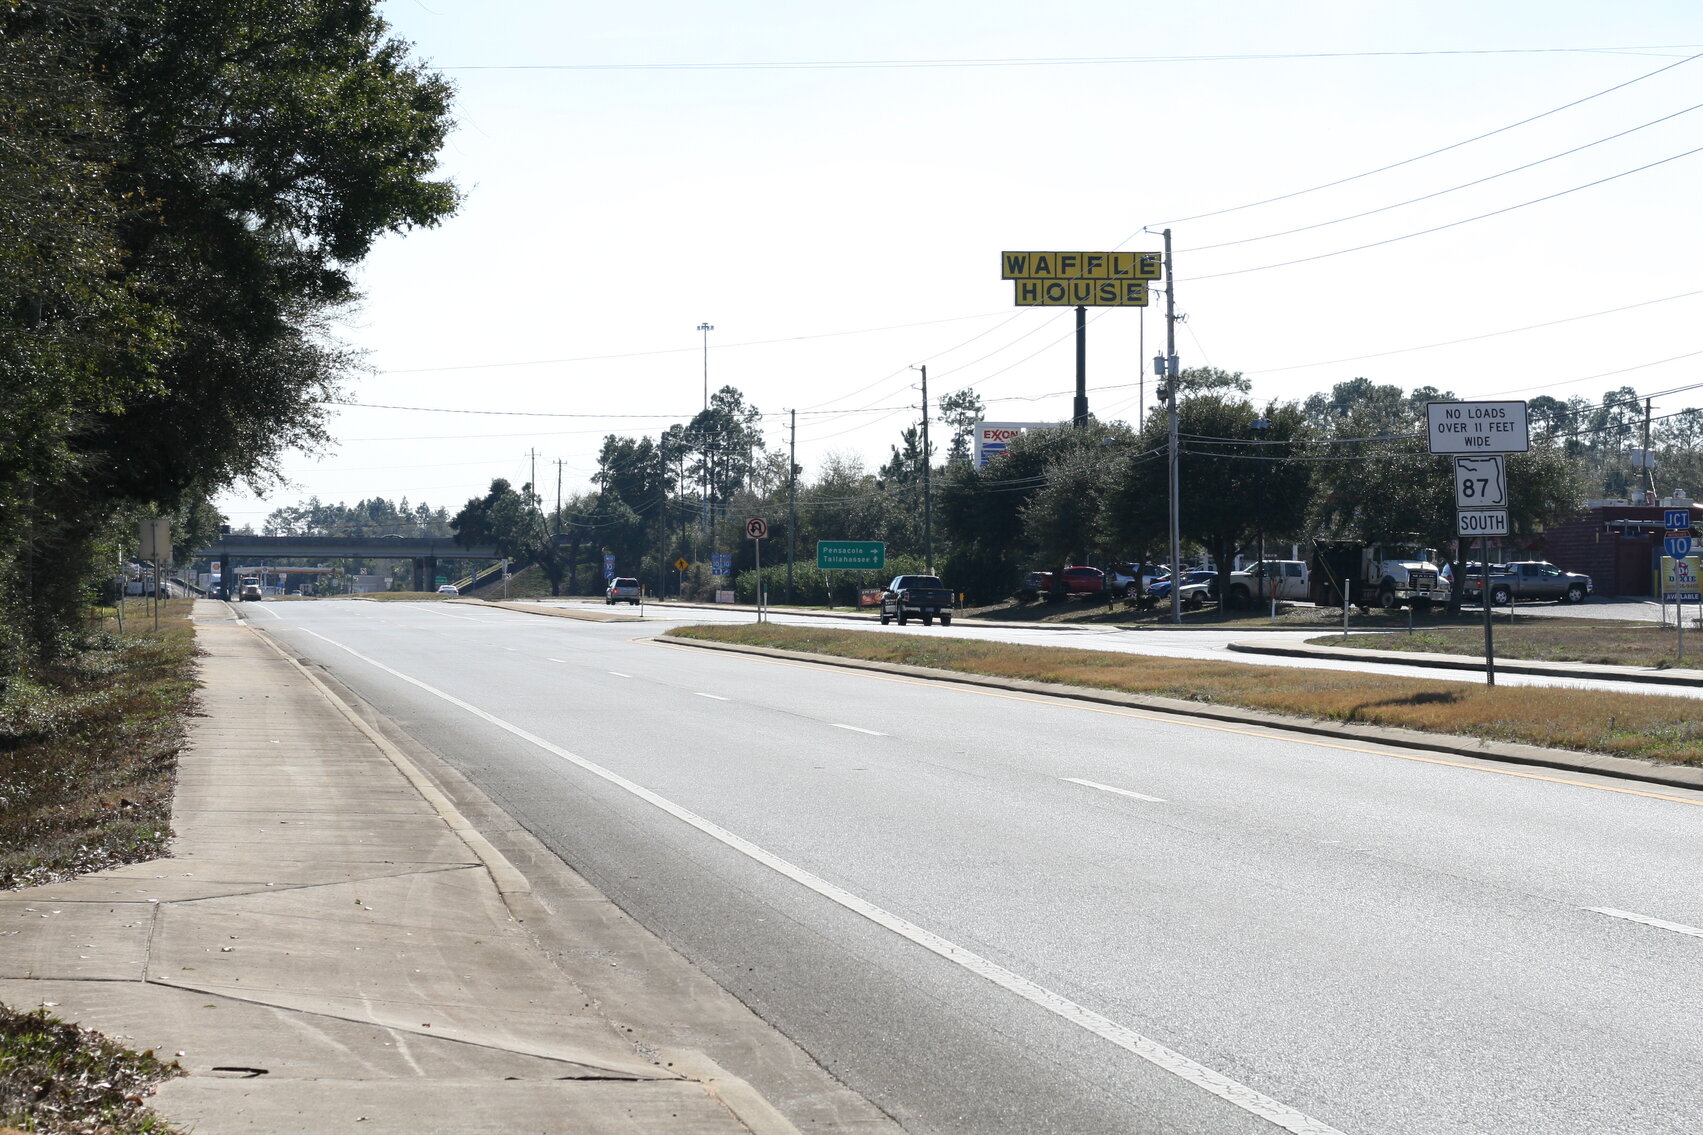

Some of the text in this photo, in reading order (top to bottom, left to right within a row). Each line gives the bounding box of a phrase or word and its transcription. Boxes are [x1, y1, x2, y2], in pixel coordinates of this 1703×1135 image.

[1006, 255, 1156, 275] WAFFLE
[1022, 282, 1143, 302] HOUSE
[1445, 408, 1506, 419] NO LOADS
[1438, 421, 1515, 434] OVER 11 FEET
[983, 429, 1019, 441] EXXON
[1464, 436, 1491, 447] WIDE
[1462, 478, 1489, 498] 87
[1461, 515, 1505, 531] SOUTH
[1666, 513, 1688, 527] JCT
[822, 546, 864, 554] Pensacola
[1670, 538, 1688, 554] 10
[823, 555, 871, 563] Tallahassee
[1668, 575, 1697, 583] DXIE
[1666, 592, 1699, 600] AVALABLE
